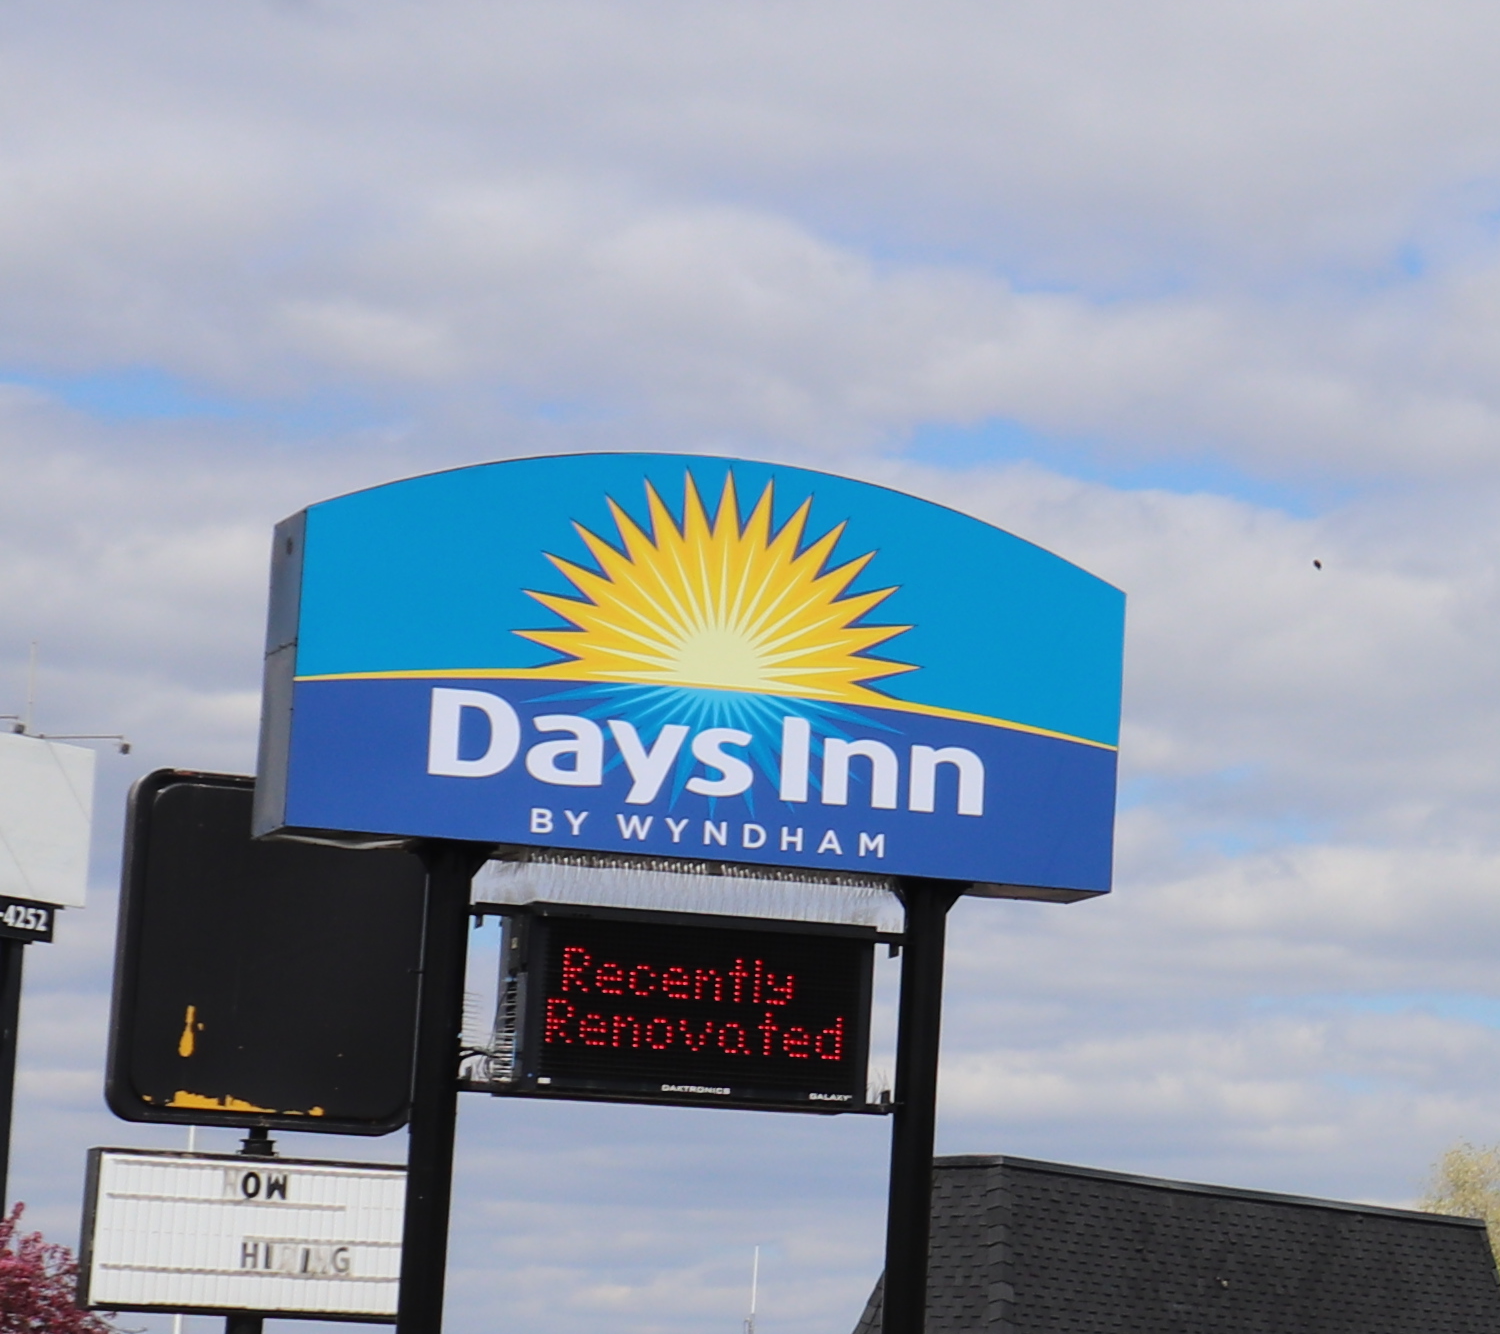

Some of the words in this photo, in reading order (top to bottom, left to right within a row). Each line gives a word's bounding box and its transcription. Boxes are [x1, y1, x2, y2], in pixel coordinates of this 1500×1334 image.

[427, 687, 753, 804] Days
[779, 716, 986, 816] Inn
[529, 807, 590, 836] BY
[616, 813, 887, 859] WYNDHAM
[561, 946, 796, 1007] Recently
[544, 998, 845, 1062] Renovated
[661, 1083, 731, 1096] DAKTRONICS
[224, 1170, 287, 1200] OW
